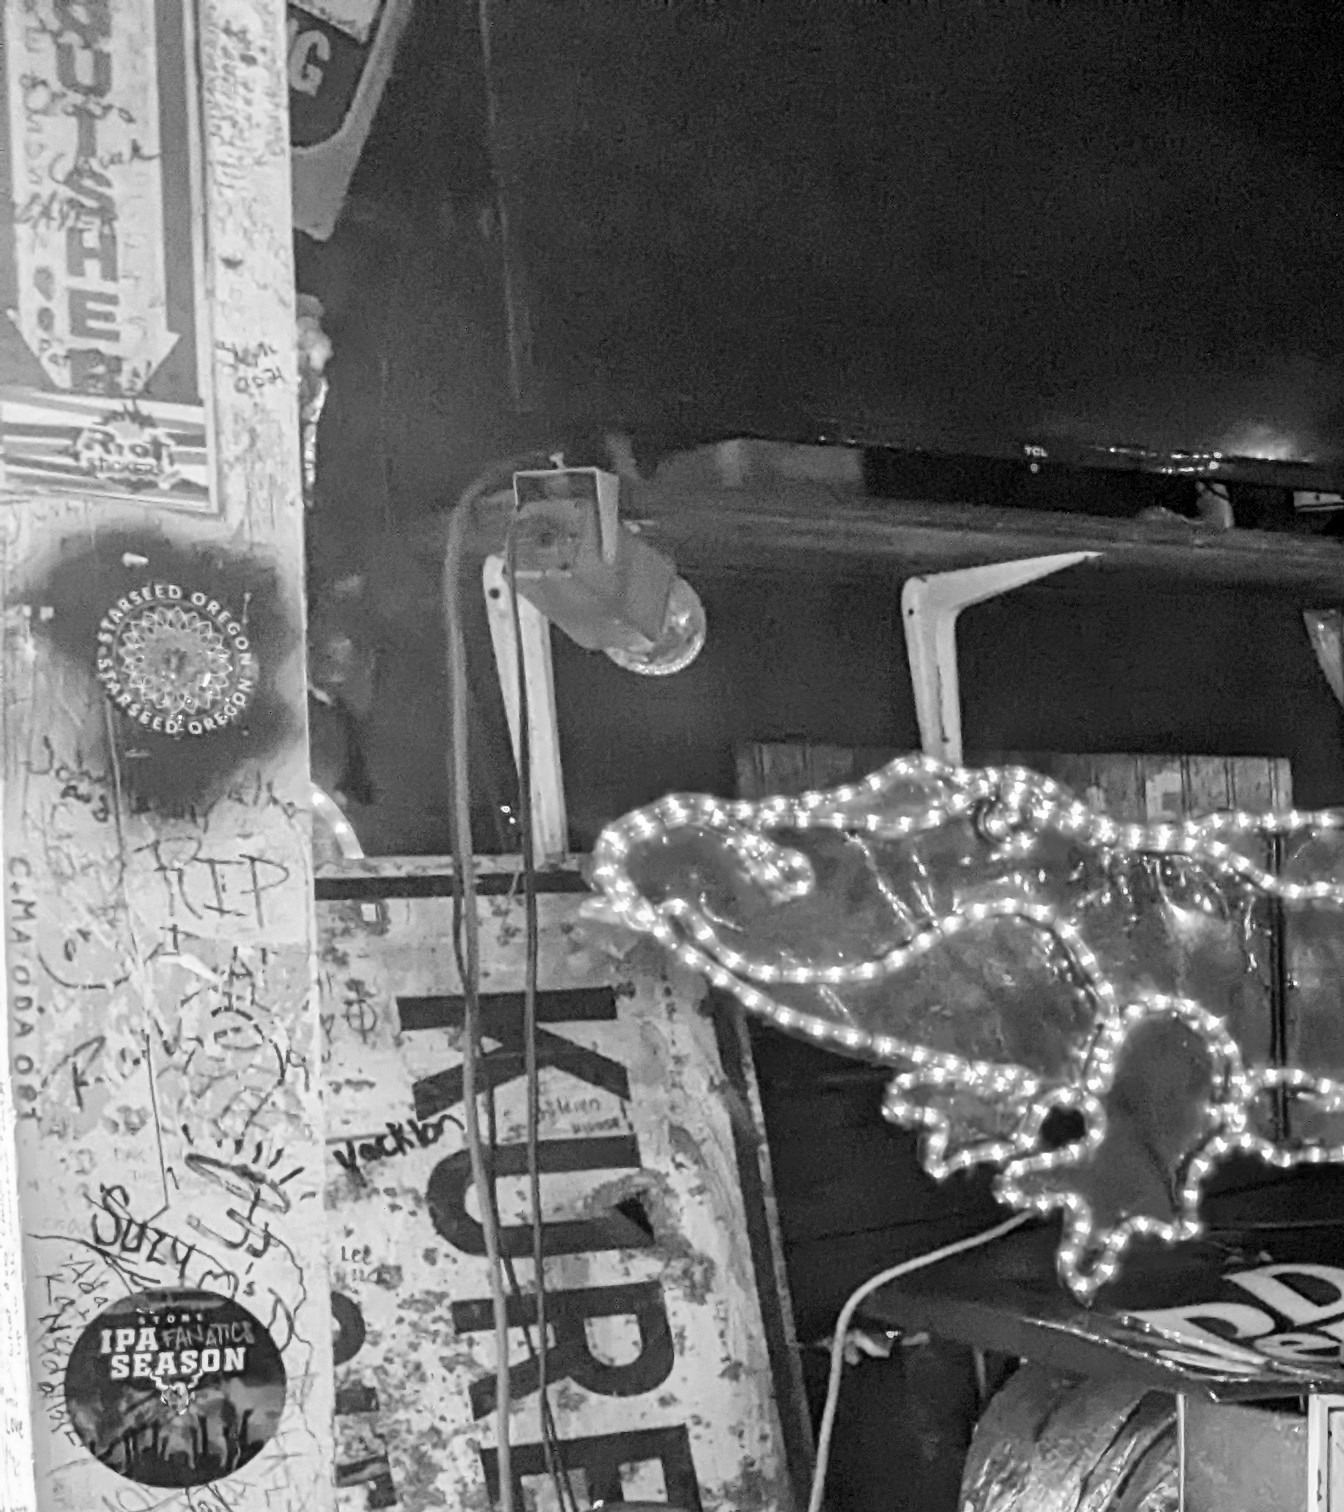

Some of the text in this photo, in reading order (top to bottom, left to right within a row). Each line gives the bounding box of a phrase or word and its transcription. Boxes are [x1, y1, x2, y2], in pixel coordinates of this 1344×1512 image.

[1024, 445, 1047, 457] TCL
[98, 584, 252, 665] STARSEED OREGON
[97, 659, 252, 735] STARSEED OREGON
[101, 1327, 159, 1354] IPA
[111, 1347, 246, 1380] SEASON
